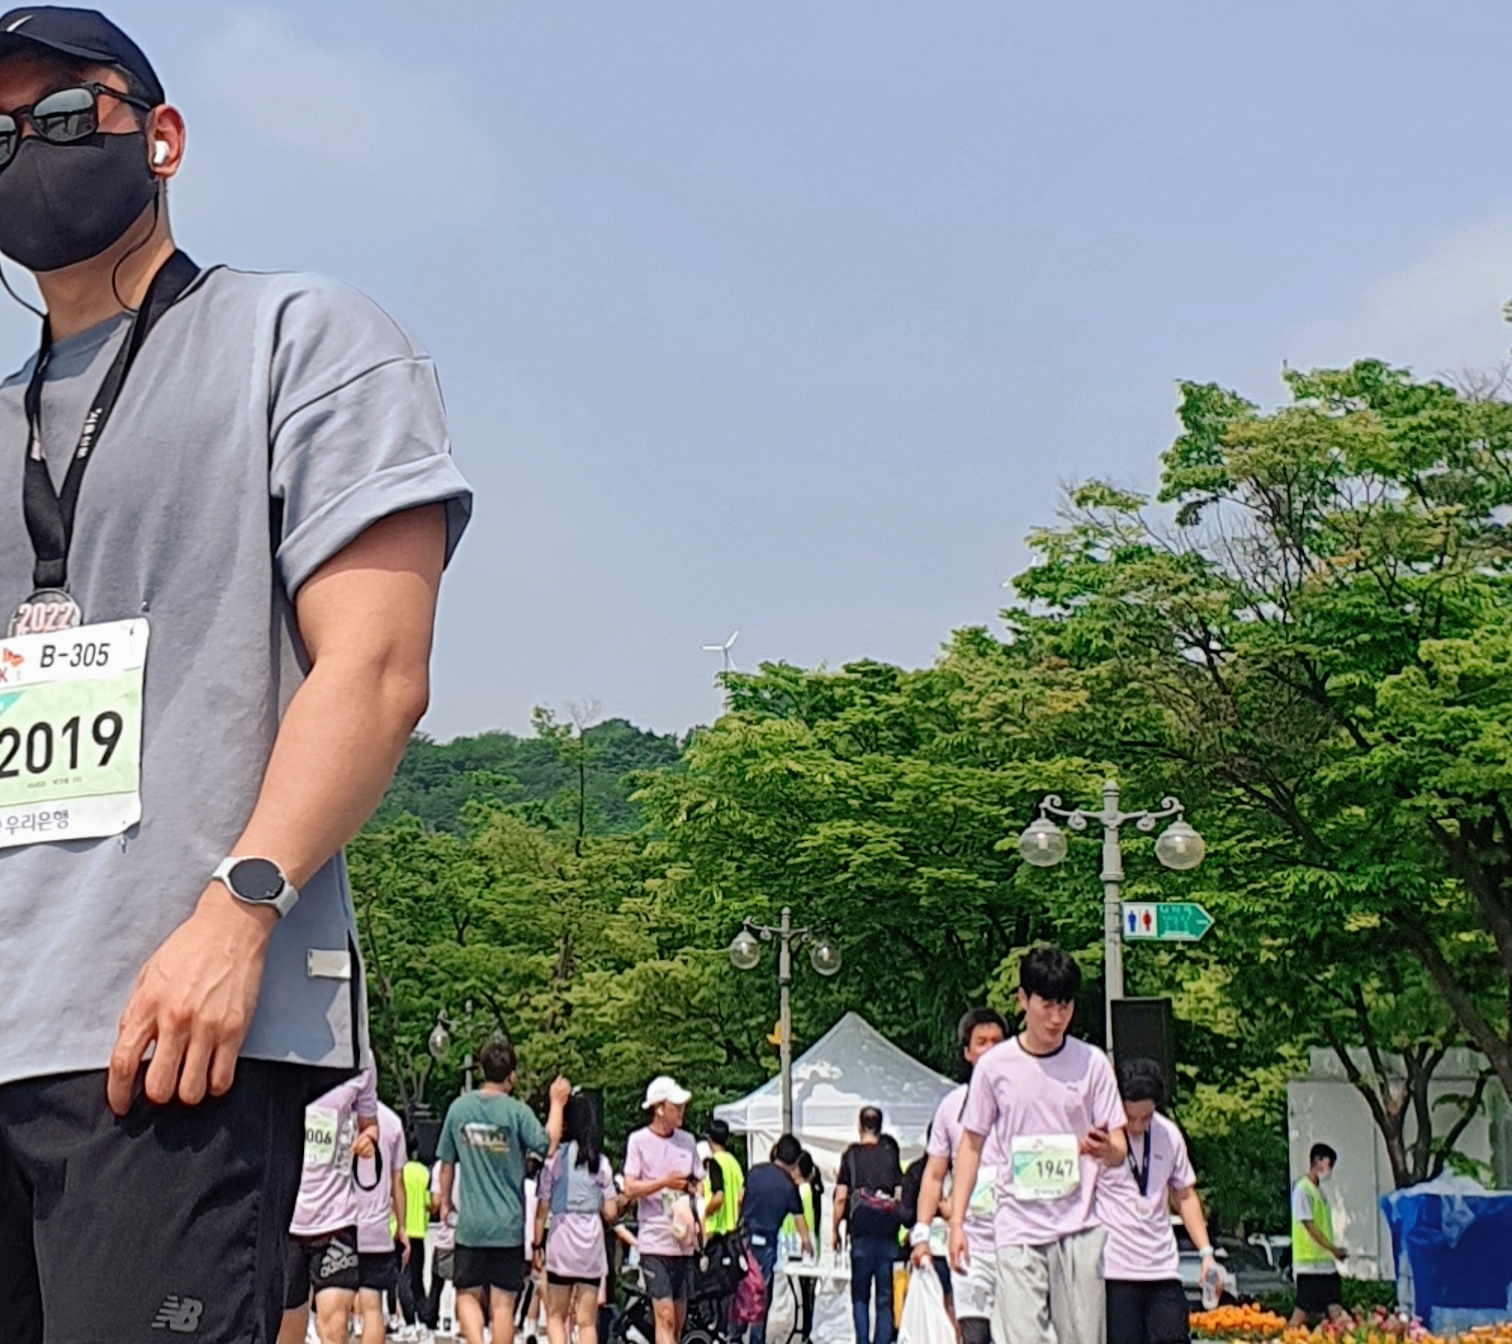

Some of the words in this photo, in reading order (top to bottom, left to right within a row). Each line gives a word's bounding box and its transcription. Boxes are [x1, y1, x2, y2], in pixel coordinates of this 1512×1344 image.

[16, 601, 76, 633] 2022
[40, 642, 111, 668] B-305
[4, 809, 69, 835] 우리은행
[1037, 1159, 1074, 1178] 1947
